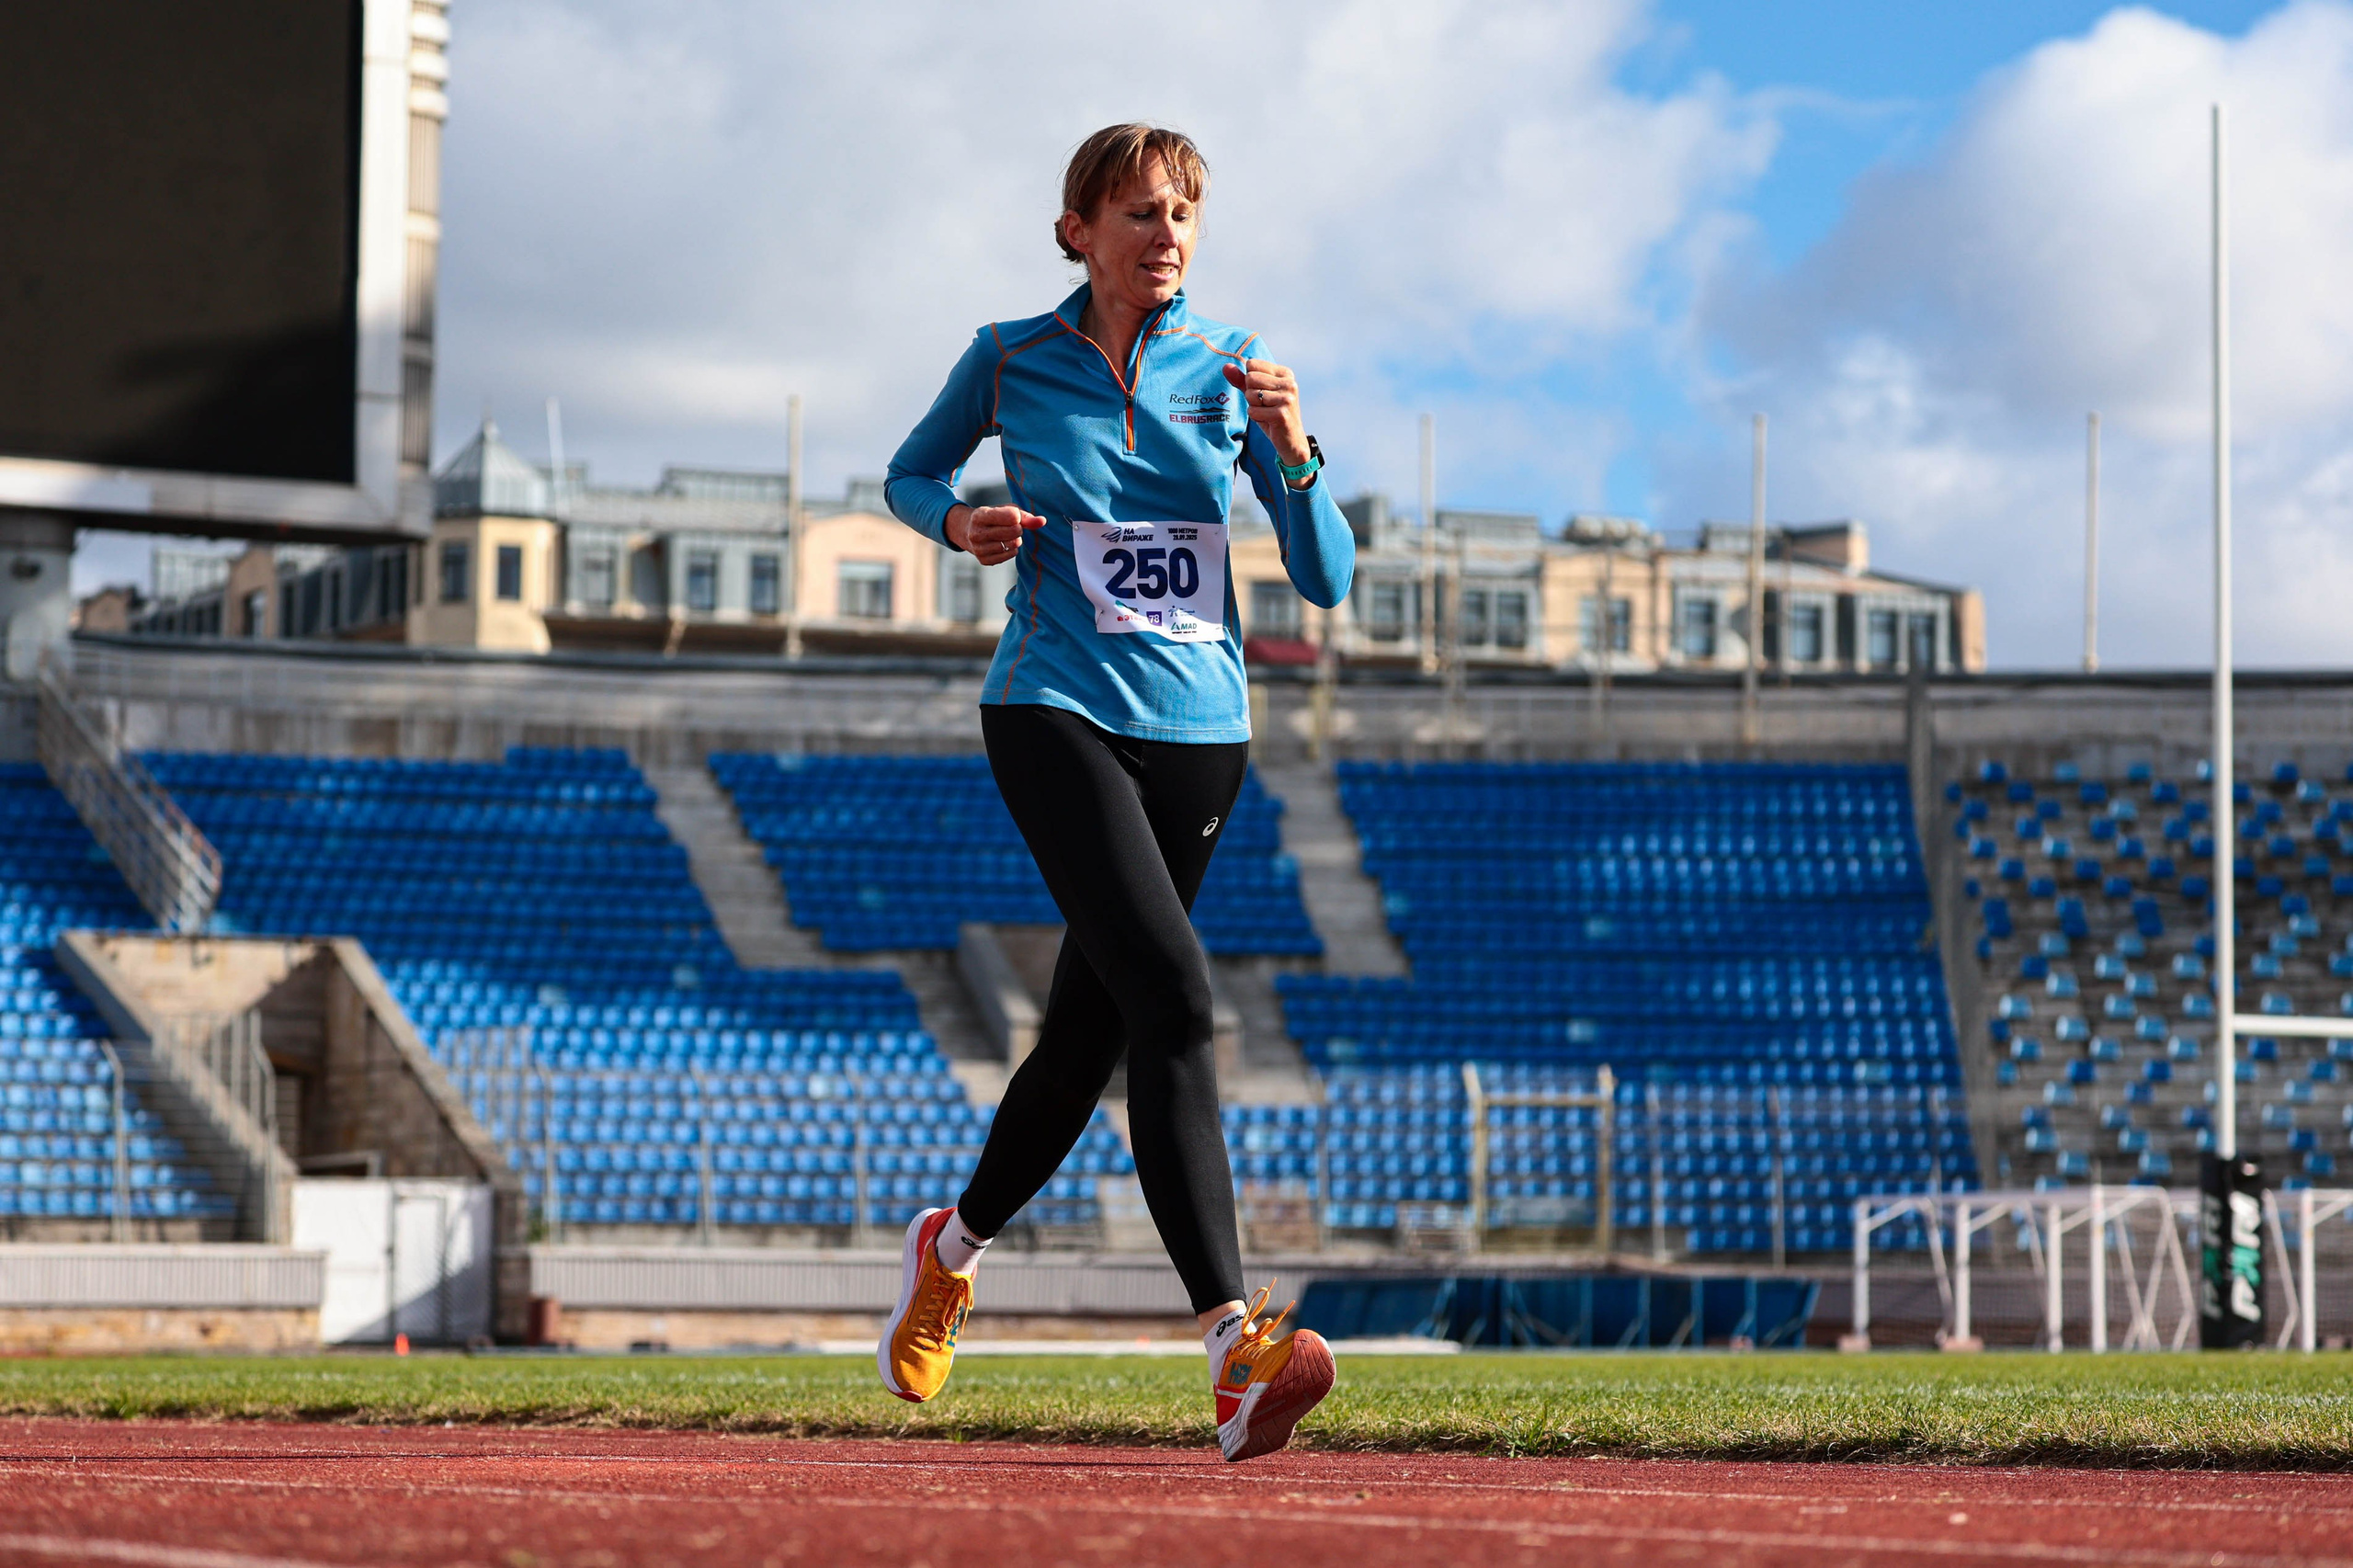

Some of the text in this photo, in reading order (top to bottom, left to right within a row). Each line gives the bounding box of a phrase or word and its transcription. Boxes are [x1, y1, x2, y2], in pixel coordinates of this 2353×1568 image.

[1169, 393, 1215, 404] RedFox
[1169, 414, 1231, 424] ELBRUSRACE
[1121, 534, 1154, 542] ВИРАЖЕ
[1102, 547, 1199, 599] 250
[1149, 614, 1160, 624] 78
